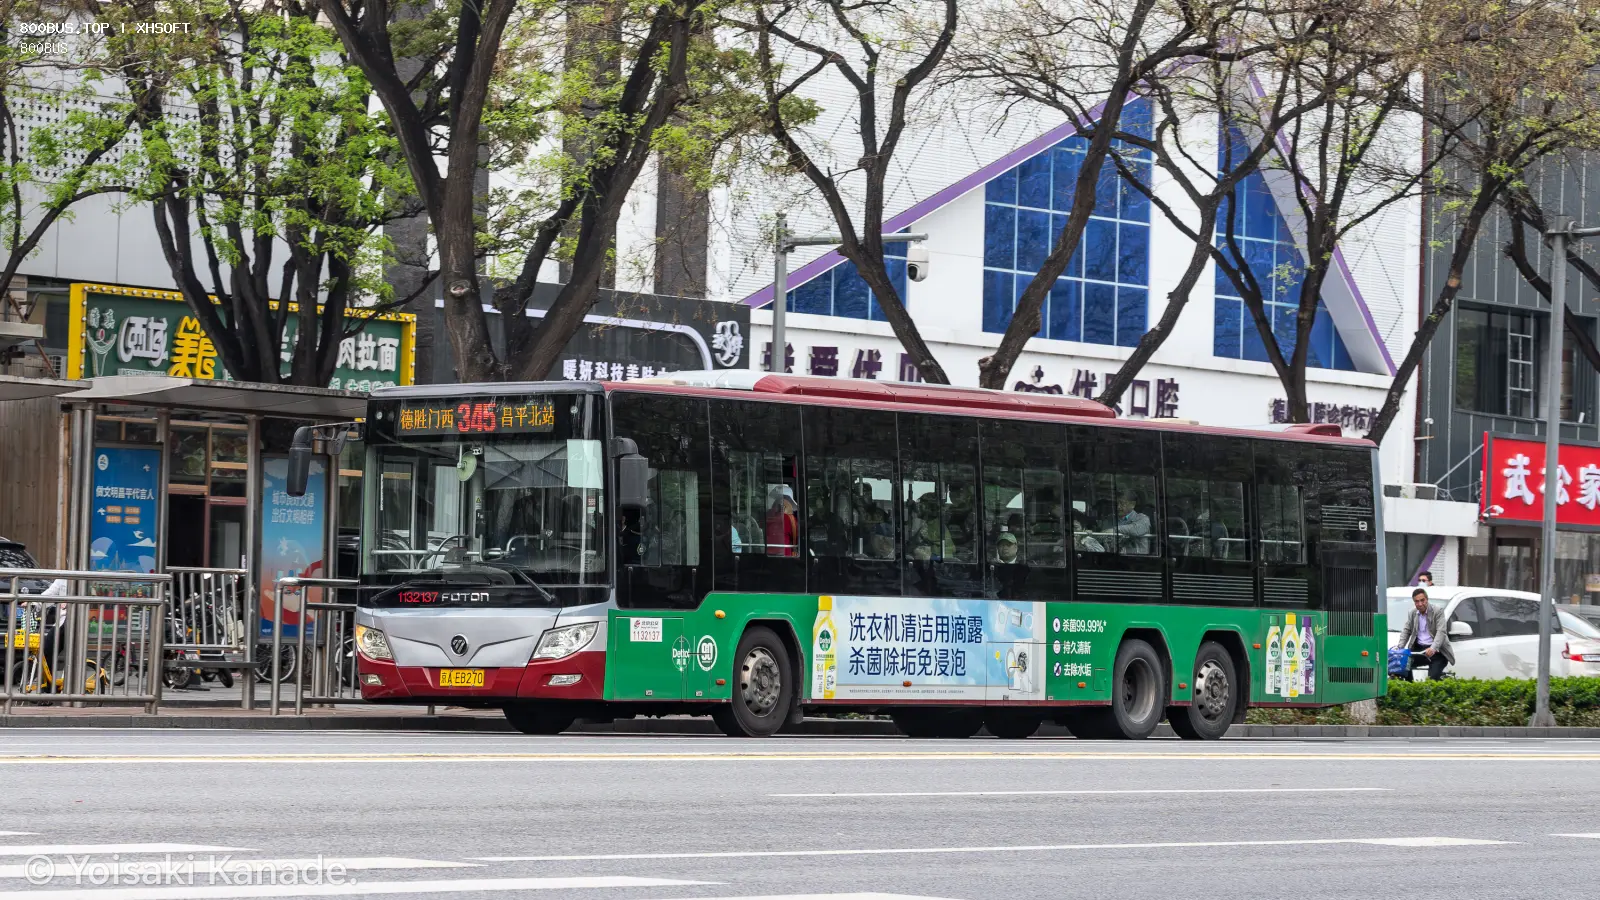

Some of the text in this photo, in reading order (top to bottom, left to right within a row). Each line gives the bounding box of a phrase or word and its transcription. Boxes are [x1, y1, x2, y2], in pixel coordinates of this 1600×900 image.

[400, 403, 556, 432] 德胜门西 345 昌平北站
[398, 591, 490, 603] 1132137 FOTON
[632, 630, 661, 641] 1132137
[849, 612, 984, 645] 洗衣机清洁用滴露
[1063, 640, 1092, 655] 持久清新
[848, 647, 967, 677] 杀菌除垢免浸泡
[1063, 662, 1092, 677] 去除水垢
